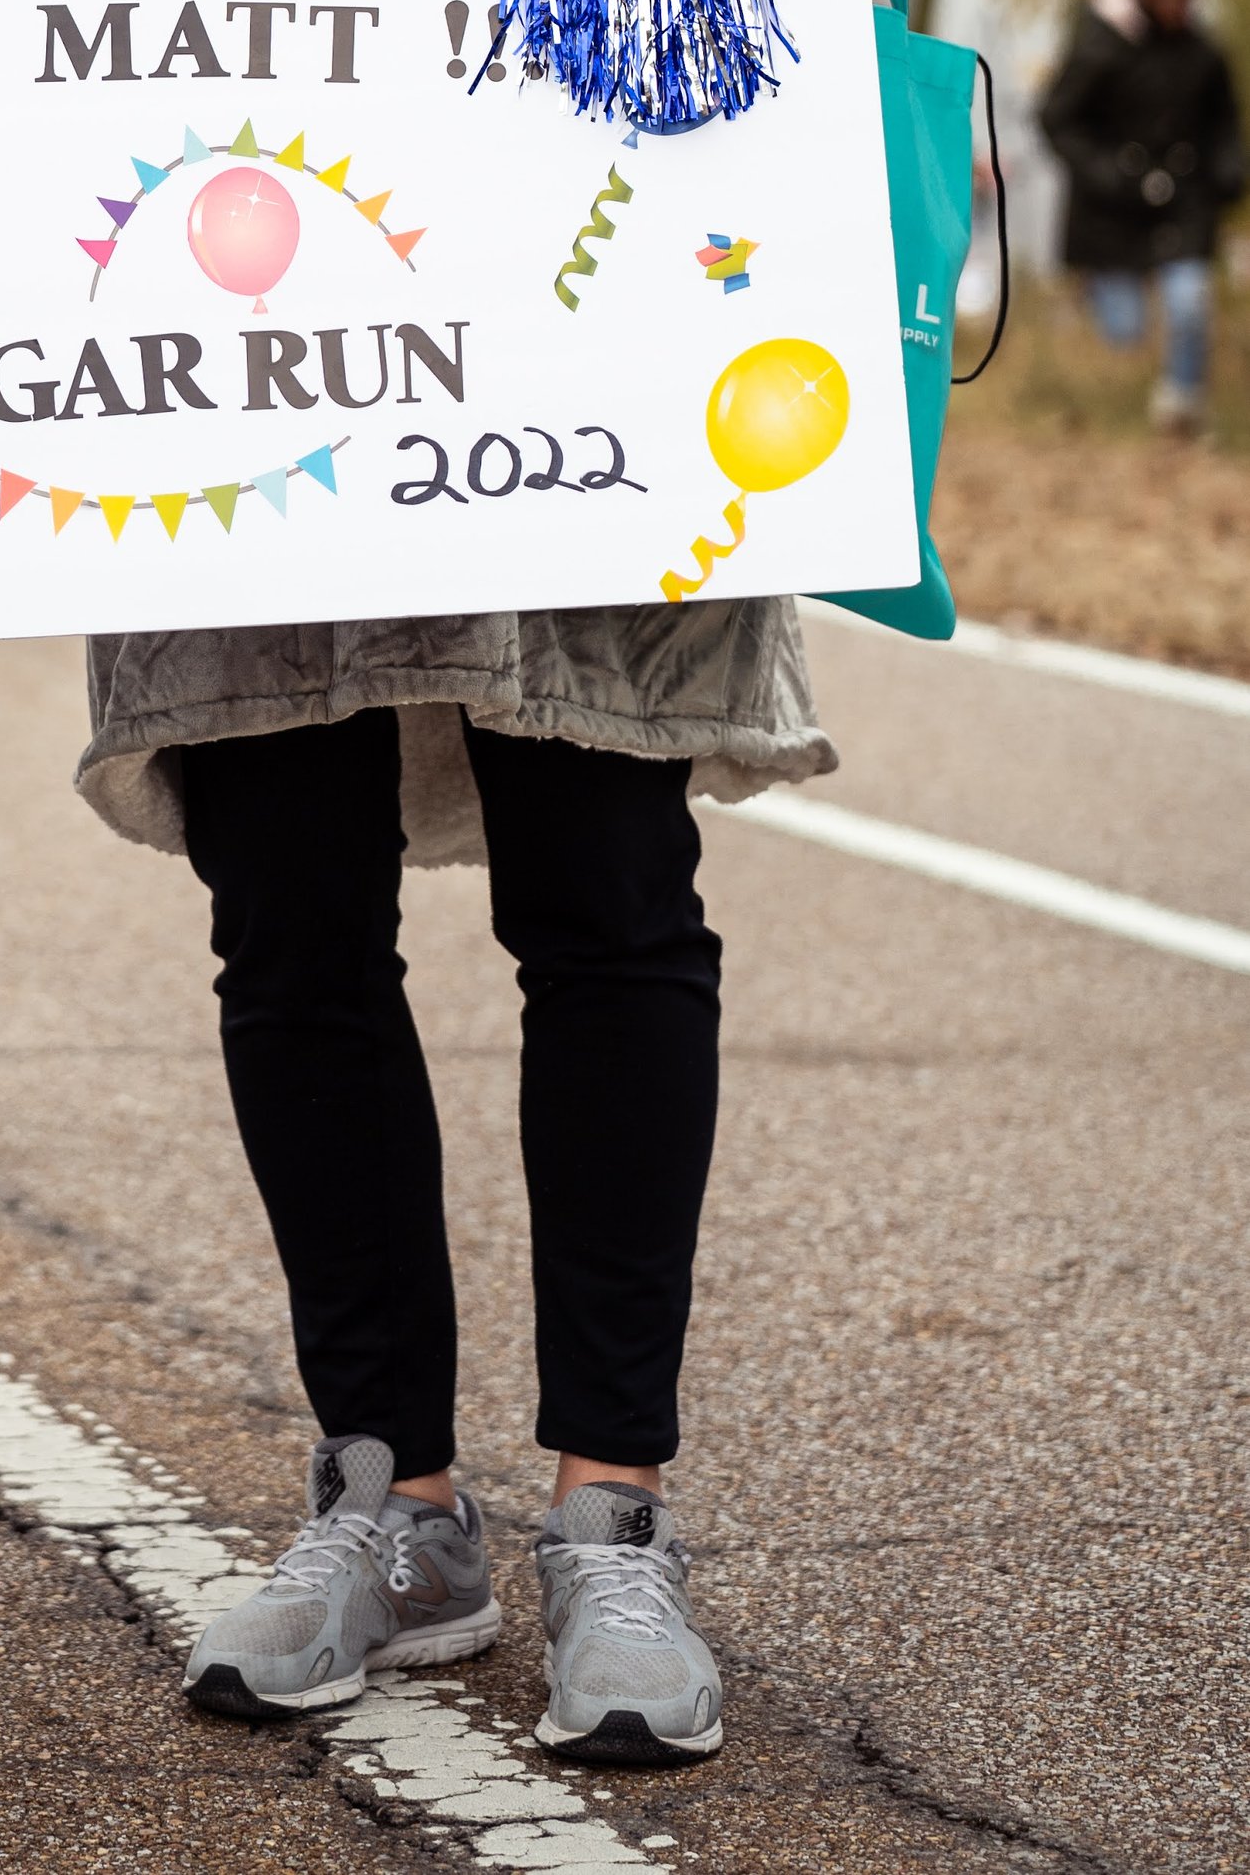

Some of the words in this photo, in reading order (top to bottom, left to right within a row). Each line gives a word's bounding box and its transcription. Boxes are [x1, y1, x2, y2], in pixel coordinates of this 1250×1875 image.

[34, 0, 380, 84] MATT
[238, 321, 471, 411] RUN
[900, 327, 938, 347] PPLY
[390, 426, 649, 506] 2022
